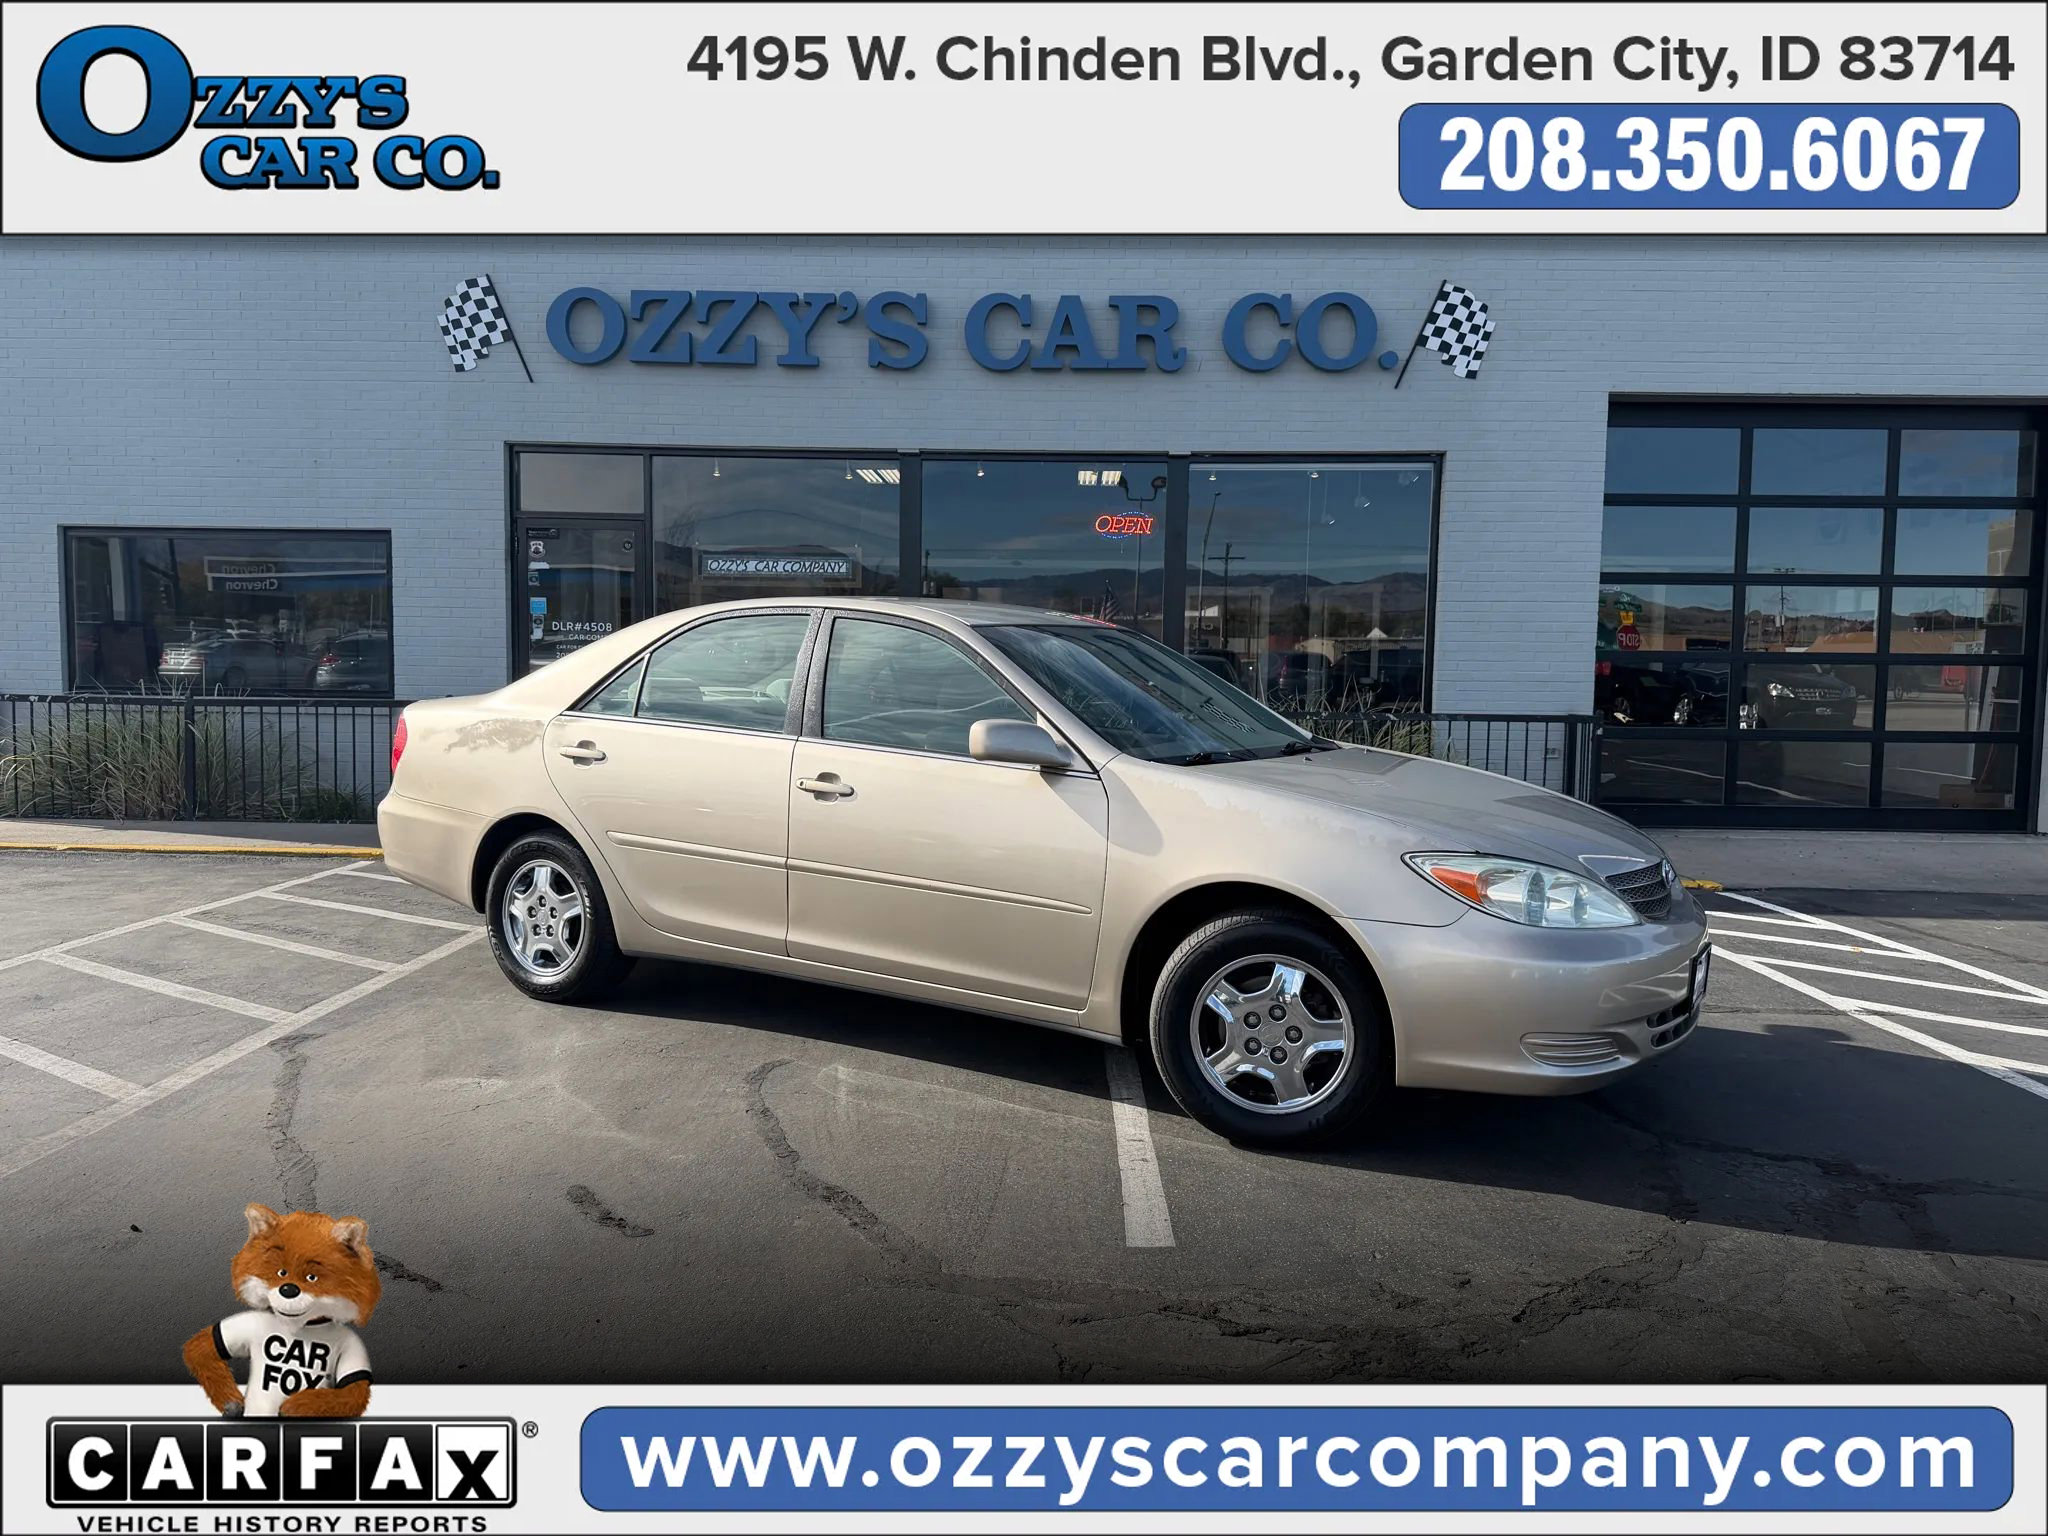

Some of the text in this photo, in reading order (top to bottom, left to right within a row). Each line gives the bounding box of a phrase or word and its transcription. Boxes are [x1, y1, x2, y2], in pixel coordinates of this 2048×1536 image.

[964, 292, 1188, 373] CAR
[1222, 291, 1399, 373] CO.
[1095, 515, 1154, 534] OPEN
[708, 559, 844, 573] OZZY'S CAR COMPANY
[551, 621, 612, 632] DLR#4508
[568, 633, 585, 641] CAR
